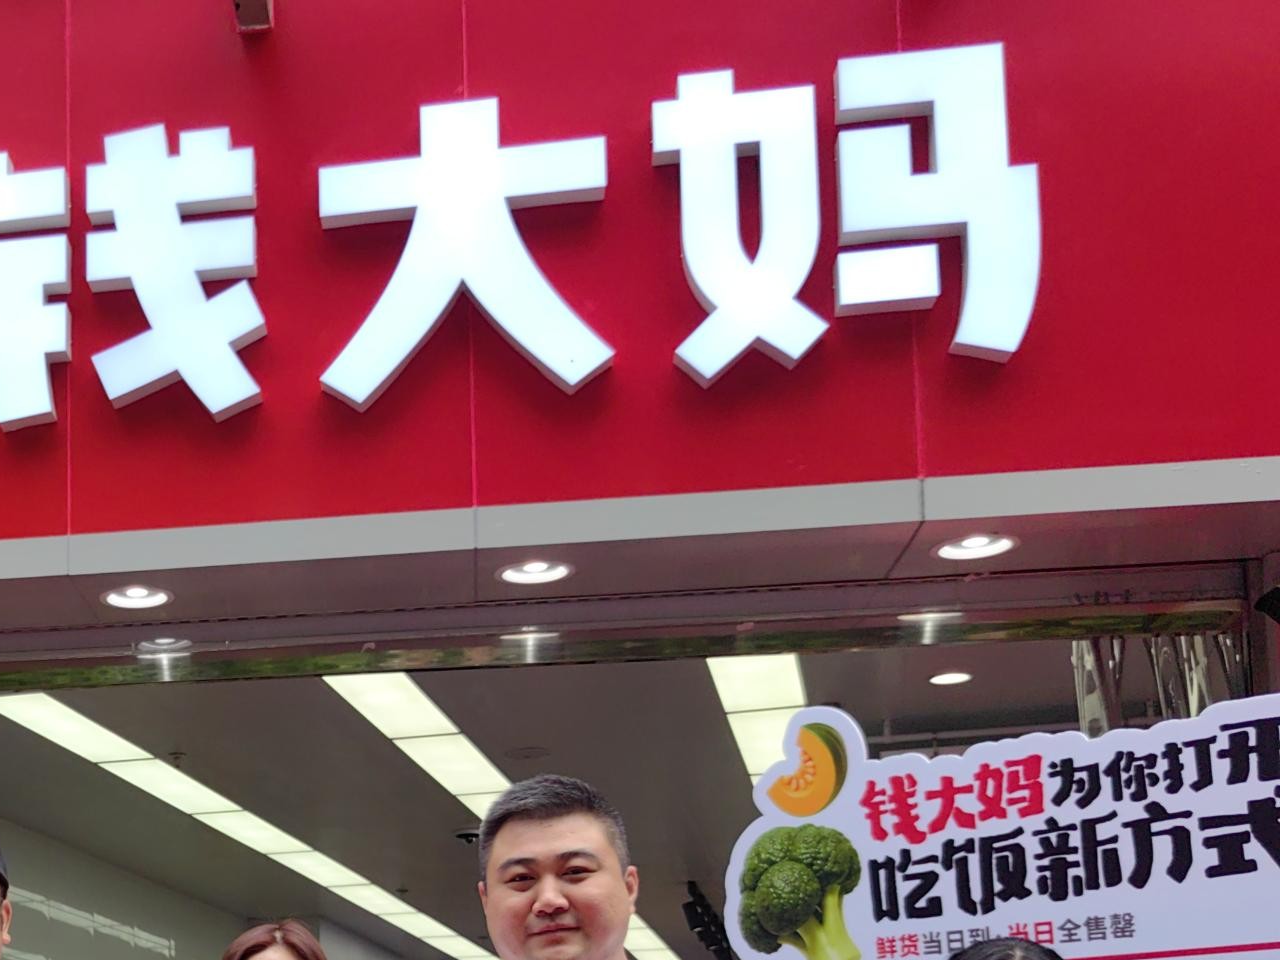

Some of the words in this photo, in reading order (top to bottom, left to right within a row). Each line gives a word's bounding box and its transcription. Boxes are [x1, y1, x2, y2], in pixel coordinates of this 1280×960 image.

[858, 716, 1280, 845] 钱大妈为你打开
[868, 785, 1280, 924] 吃饭新方式
